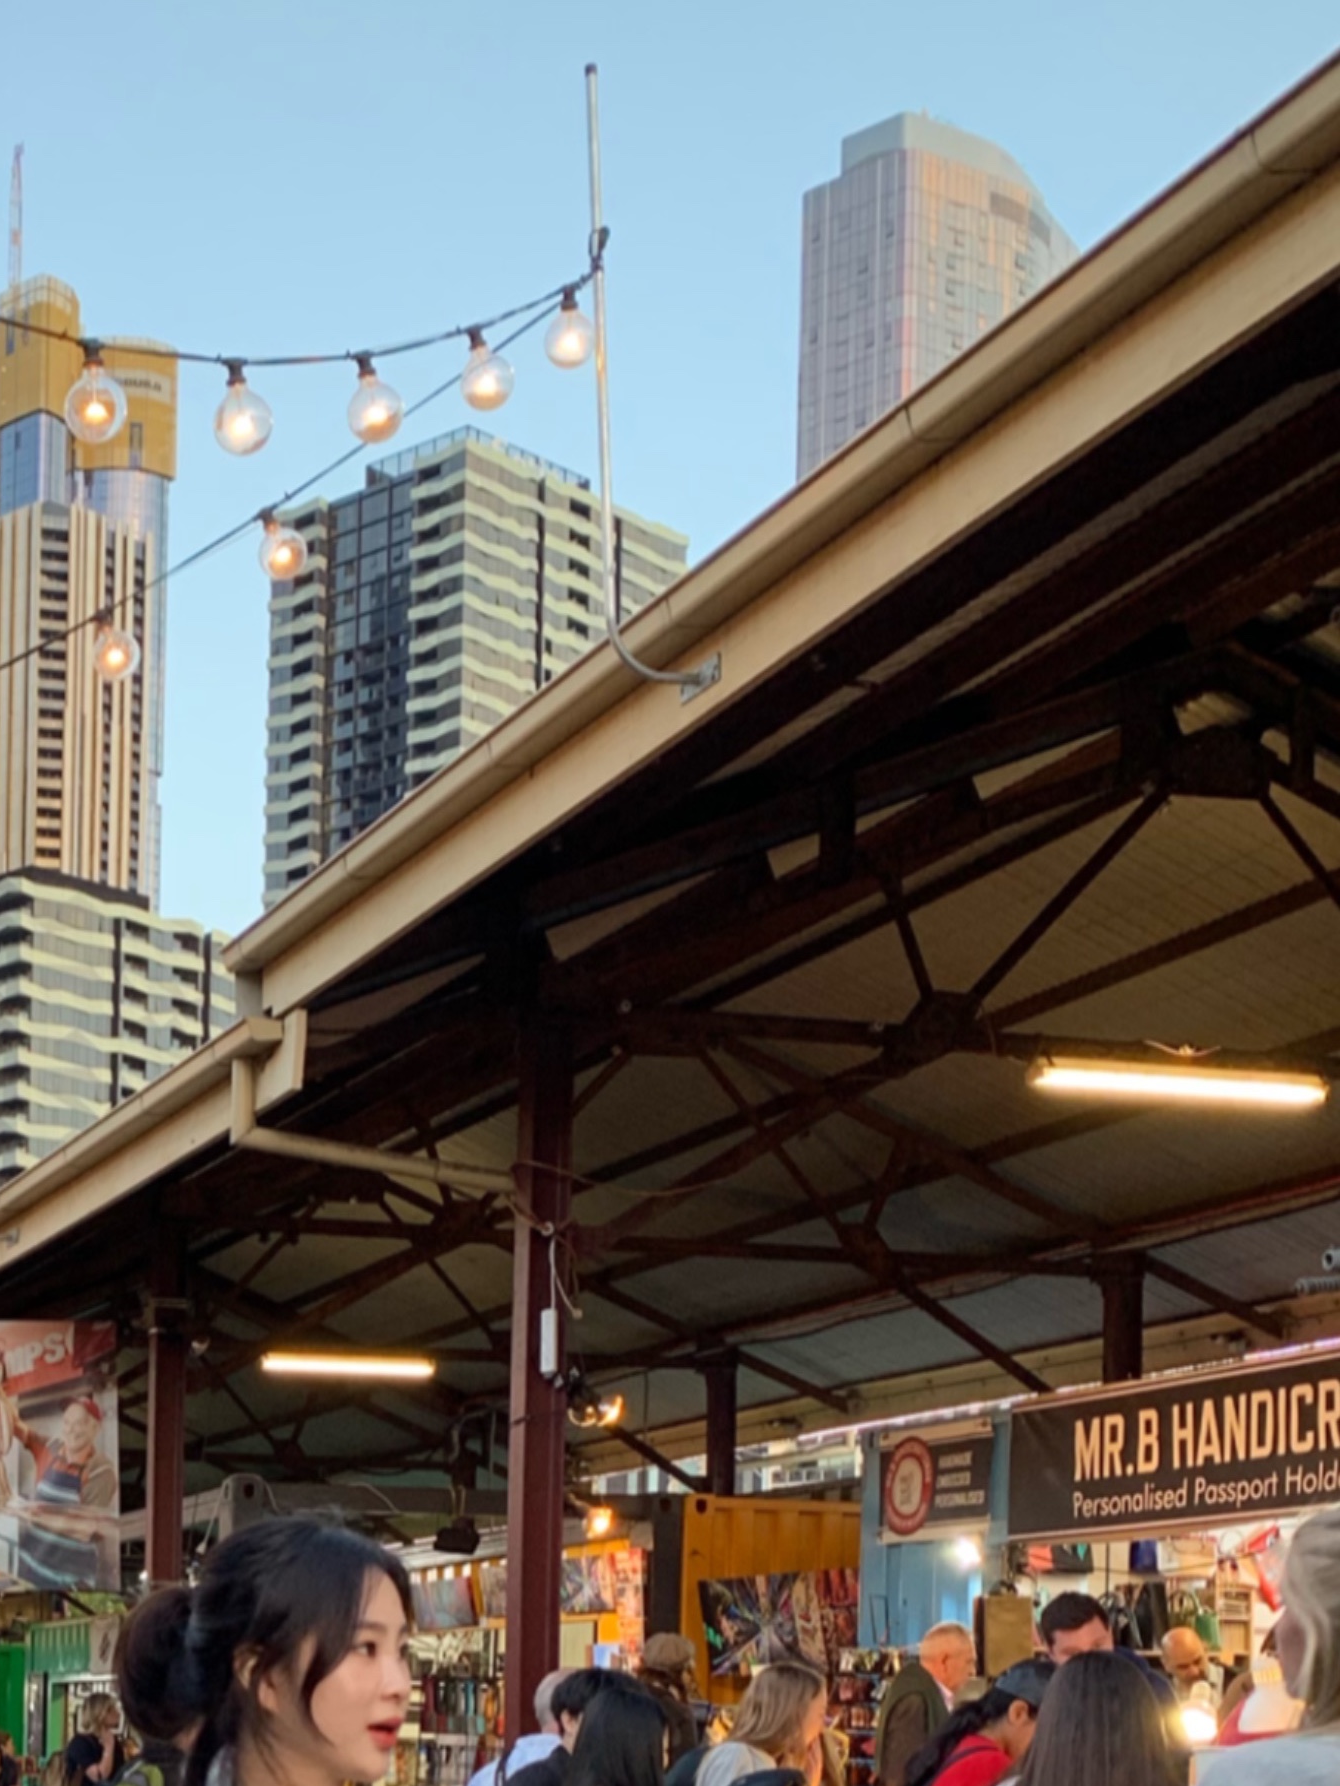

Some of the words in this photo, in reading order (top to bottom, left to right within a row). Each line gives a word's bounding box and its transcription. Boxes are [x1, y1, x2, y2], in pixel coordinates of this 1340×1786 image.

[1073, 1408, 1160, 1482] MR.B
[1172, 1379, 1340, 1470] HANDICR
[1072, 1477, 1188, 1518] Personalised
[1194, 1470, 1278, 1508] Passport
[1285, 1459, 1340, 1496] Hold
